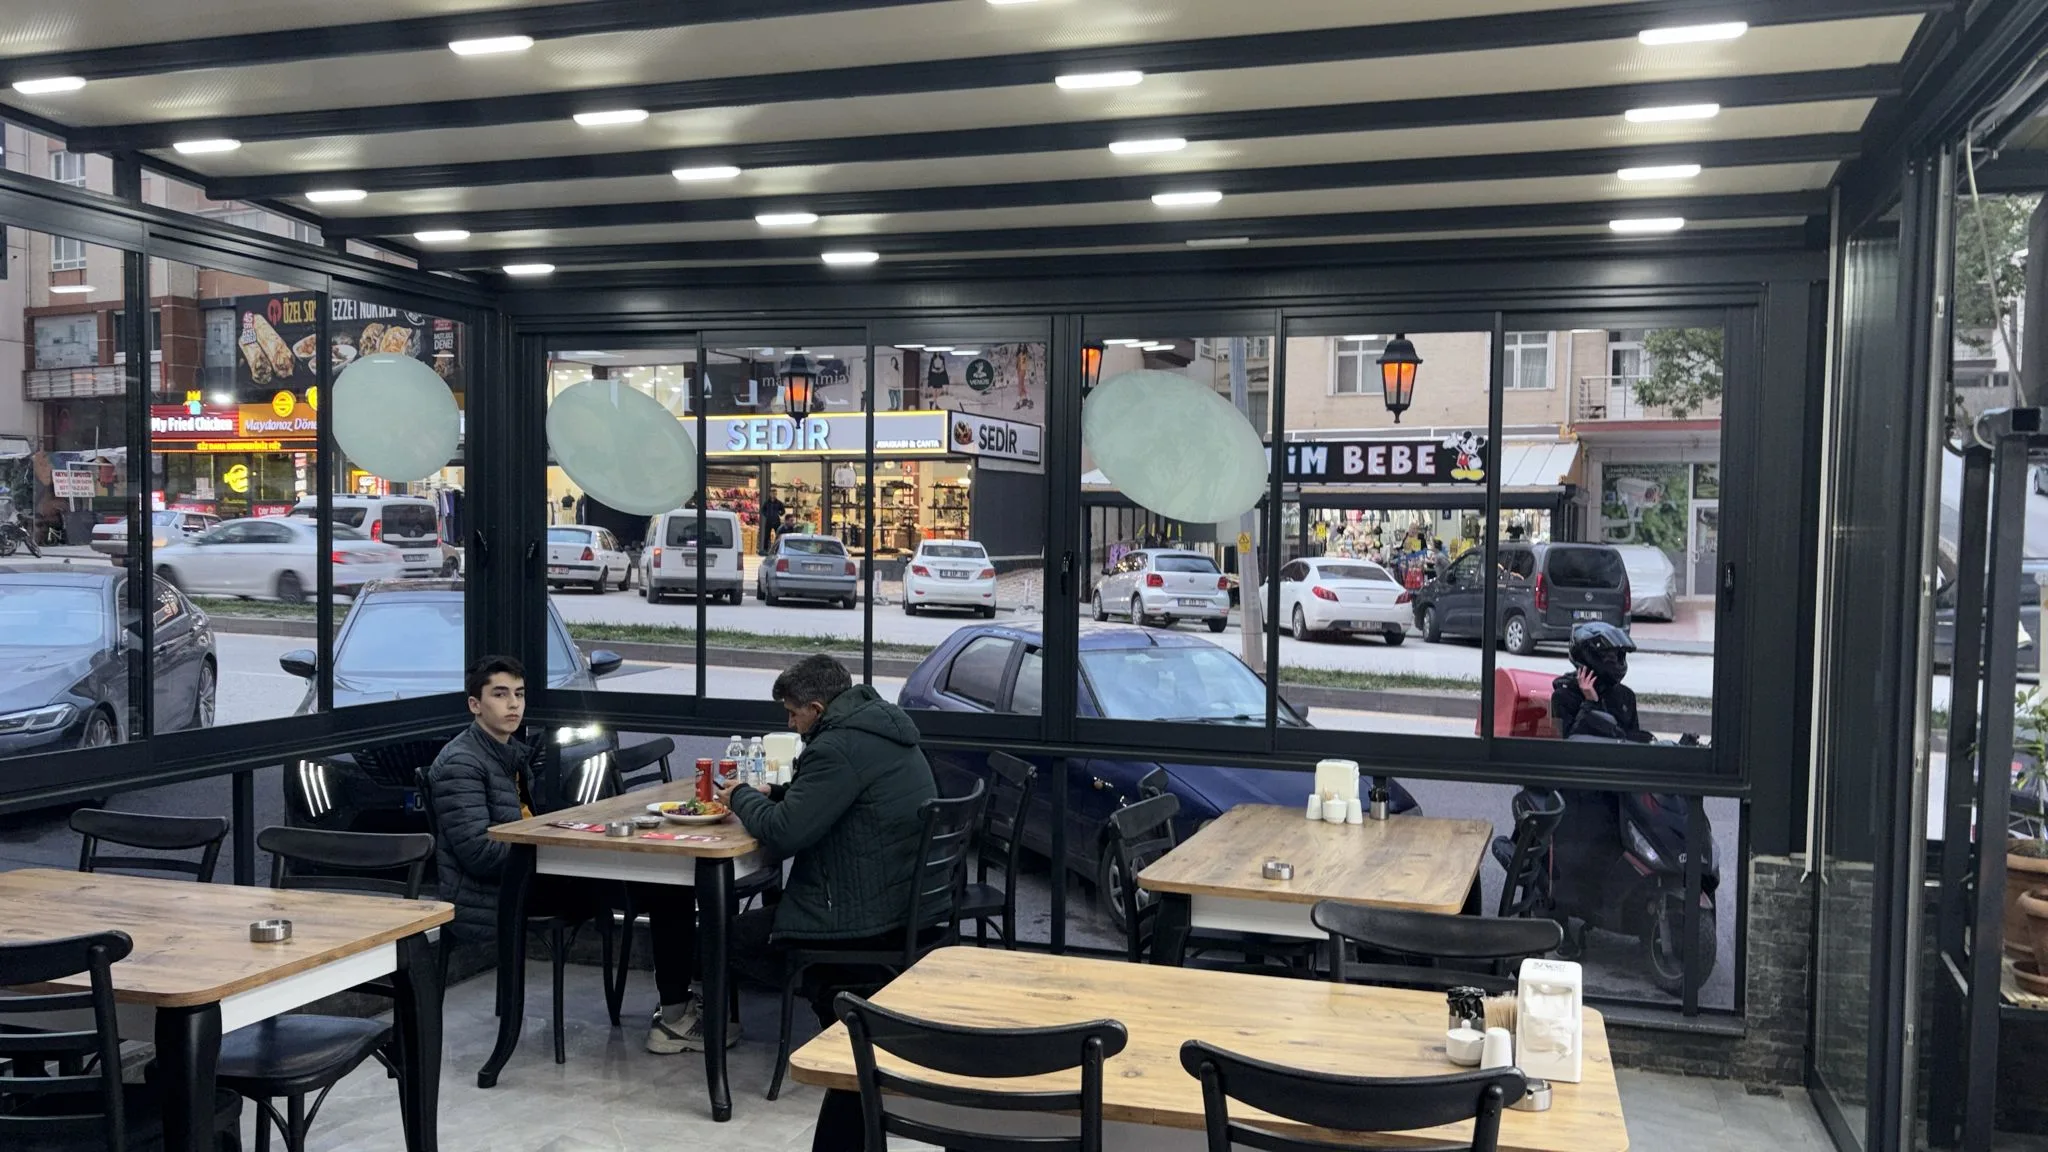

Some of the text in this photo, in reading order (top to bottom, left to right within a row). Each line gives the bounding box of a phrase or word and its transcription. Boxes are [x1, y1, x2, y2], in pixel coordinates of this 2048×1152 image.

[168, 417, 194, 431] Fried
[195, 417, 232, 431] Chicken
[727, 418, 831, 451] SEDİR
[978, 423, 1017, 453] SEDİR
[1343, 445, 1436, 475] BEBE
